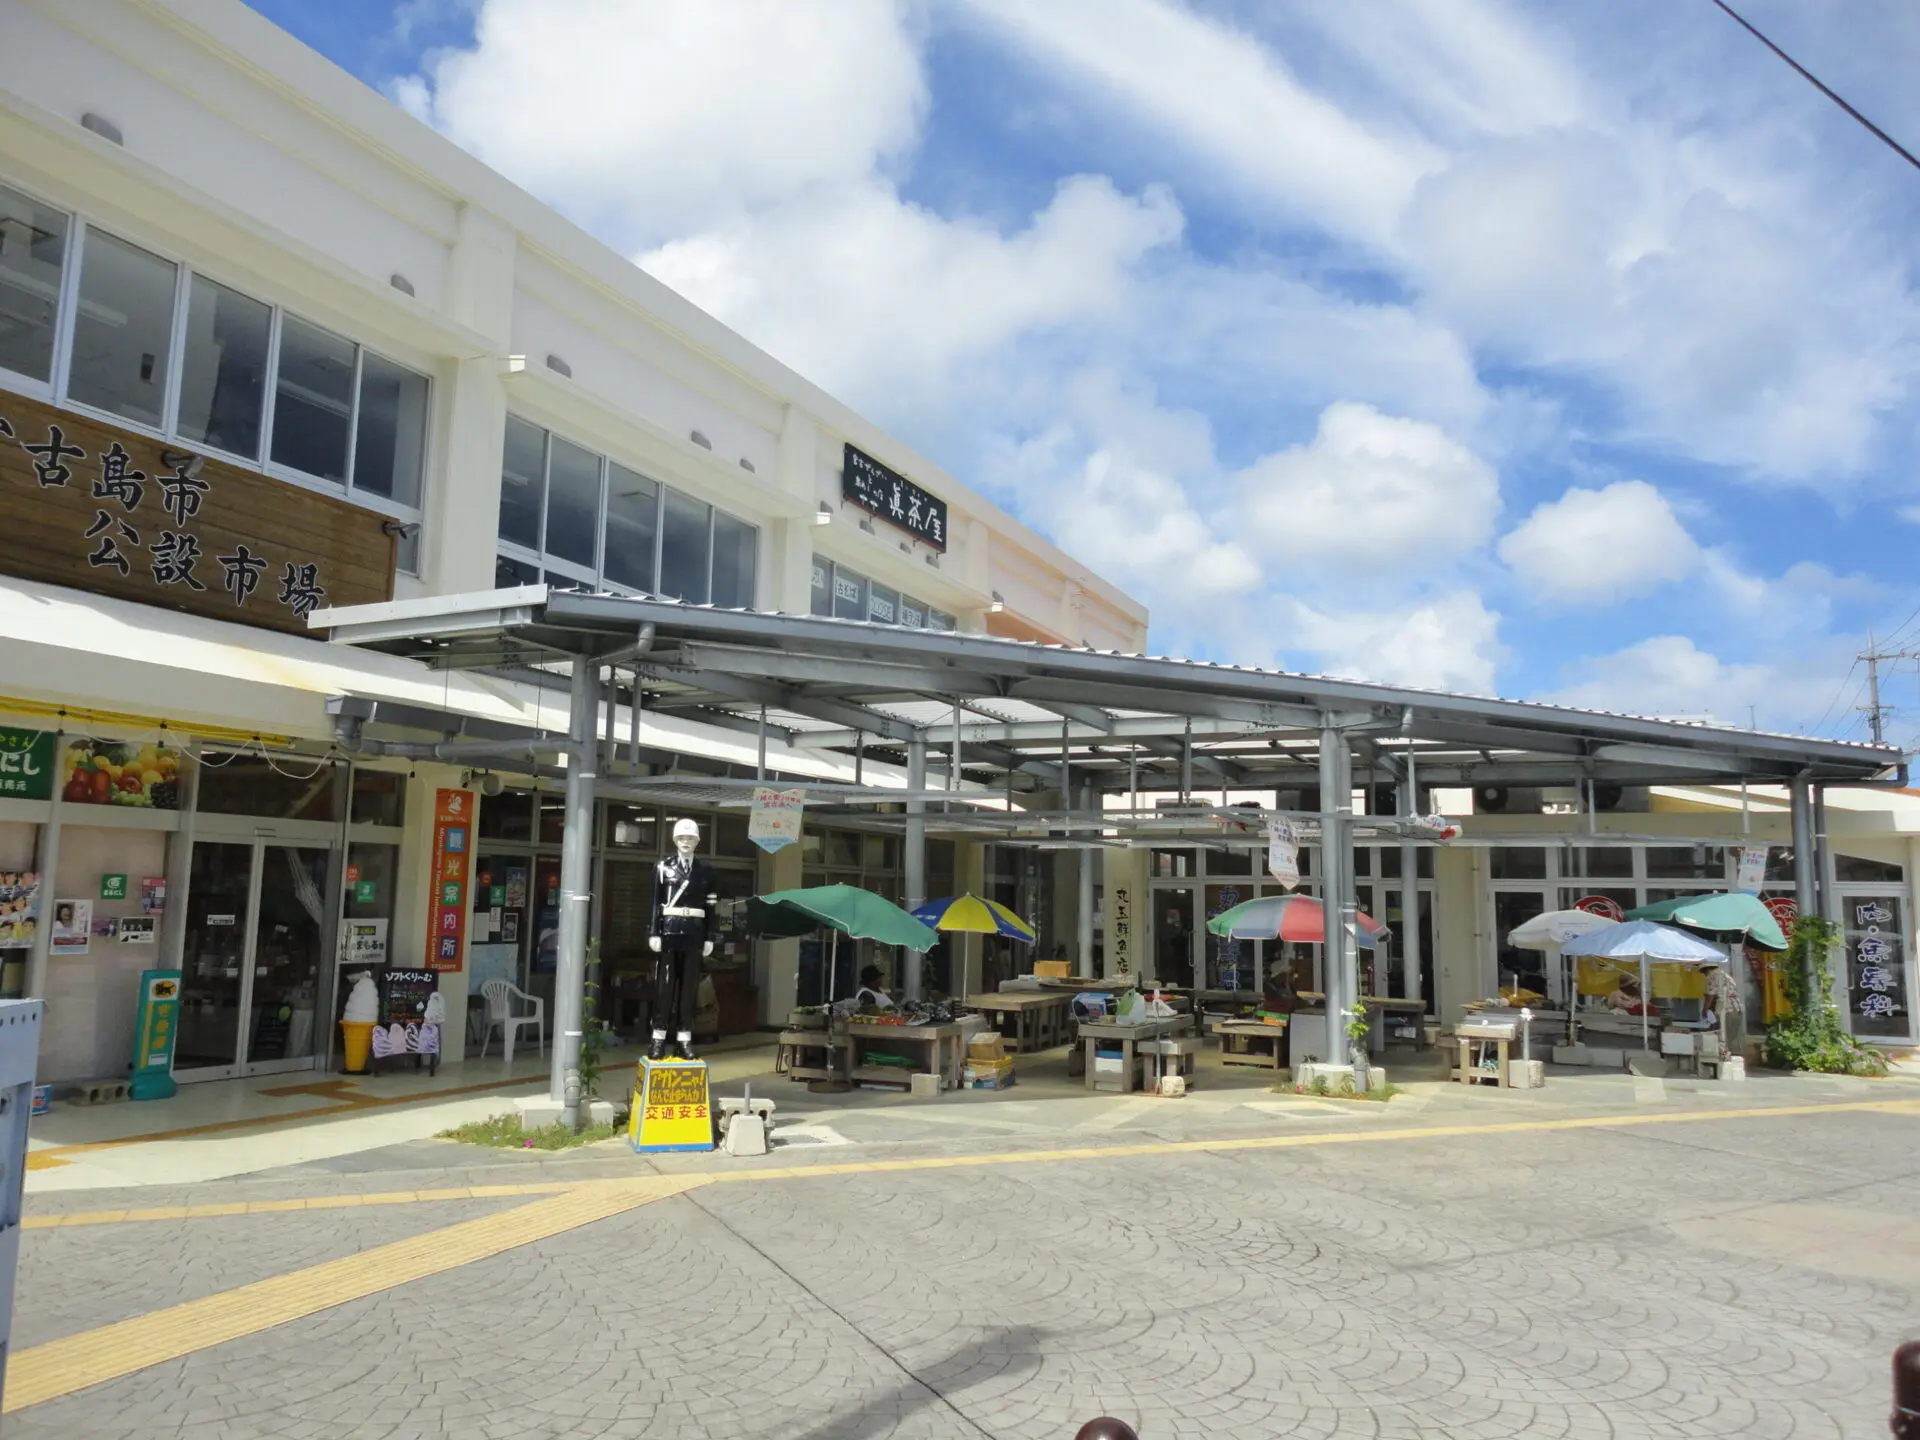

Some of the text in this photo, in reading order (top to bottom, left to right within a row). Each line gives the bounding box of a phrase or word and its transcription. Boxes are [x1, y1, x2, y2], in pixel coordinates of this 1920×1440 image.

[0, 417, 210, 527] 古島市
[85, 510, 325, 621] 公設市場
[440, 831, 464, 958] 観光案内所
[645, 1104, 708, 1120] 交通安全
